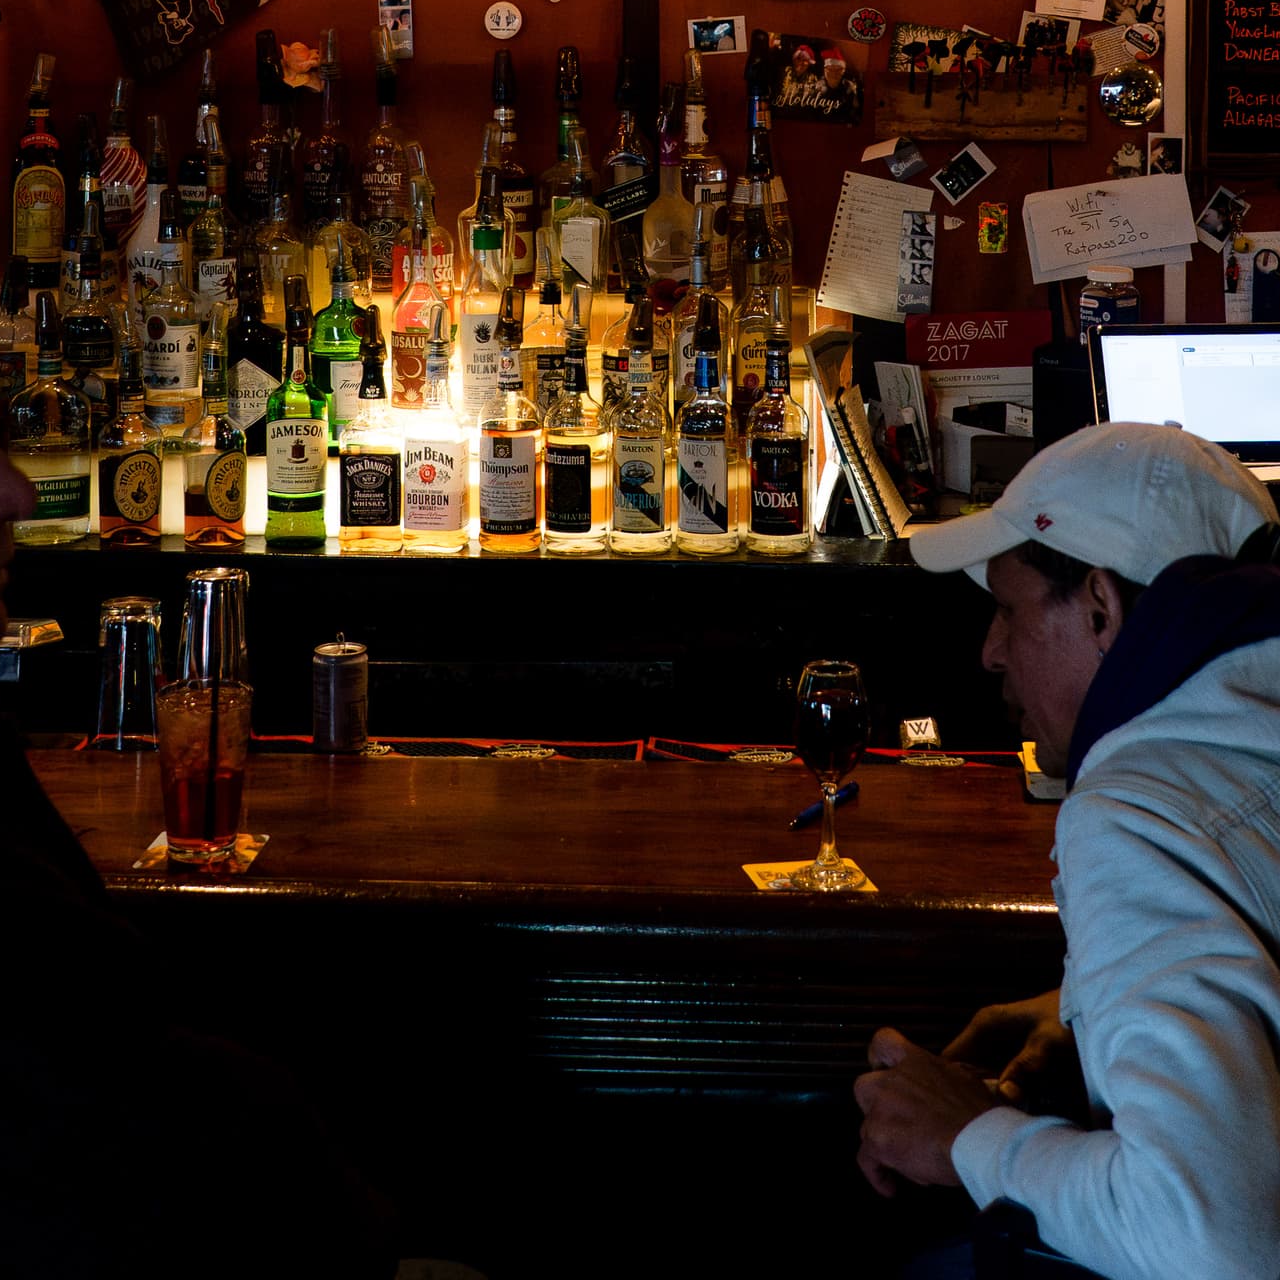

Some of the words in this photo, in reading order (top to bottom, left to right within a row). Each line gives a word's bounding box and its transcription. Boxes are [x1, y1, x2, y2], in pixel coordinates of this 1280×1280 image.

[927, 320, 1009, 341] ZAGAT
[927, 344, 970, 363] 2017
[270, 424, 324, 440] JAMESON
[622, 445, 655, 453] BARTON
[404, 450, 422, 467] JIM
[424, 447, 454, 469] BEAM
[346, 462, 364, 476] JACK
[407, 492, 449, 505] BOURBON
[752, 491, 799, 508] VODKA
